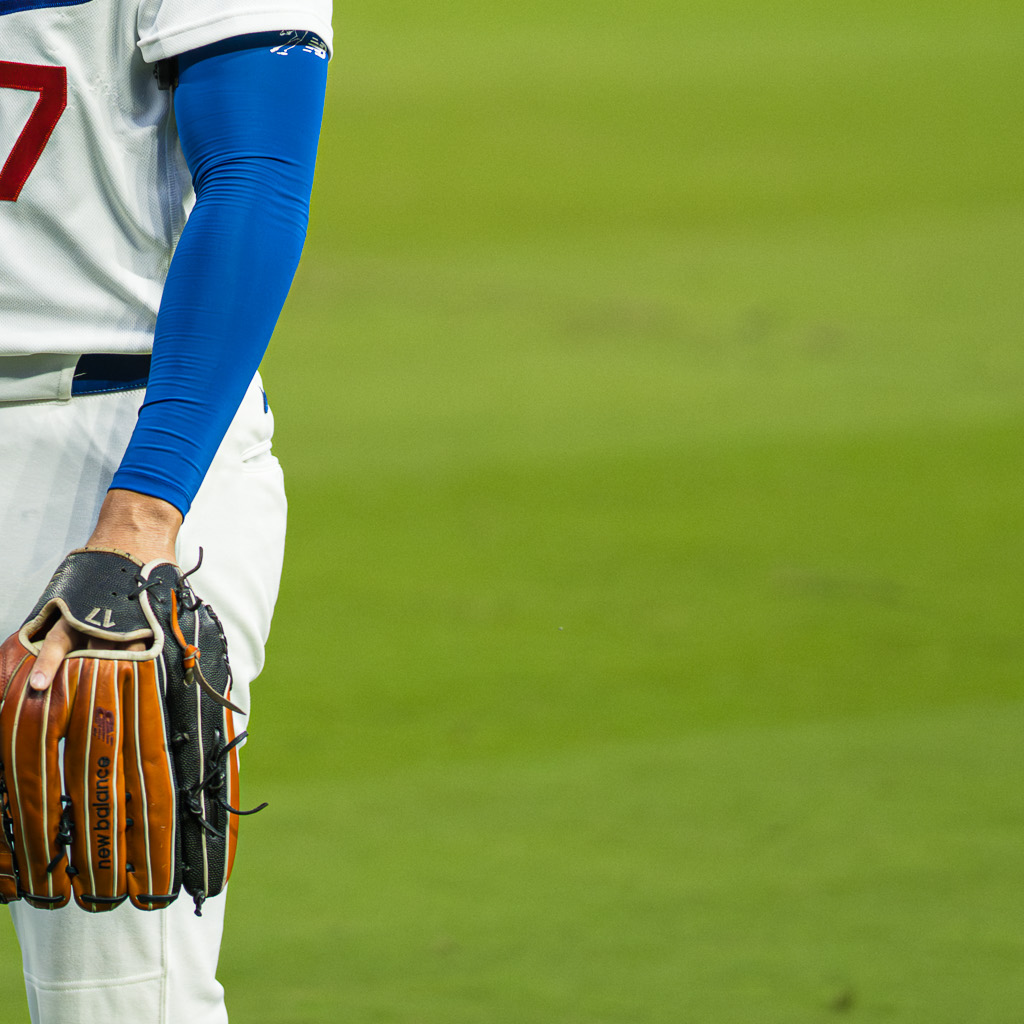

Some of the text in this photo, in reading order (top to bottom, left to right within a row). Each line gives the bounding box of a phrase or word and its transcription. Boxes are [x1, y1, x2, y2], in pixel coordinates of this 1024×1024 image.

[85, 607, 116, 628] 17
[92, 756, 111, 870] new balance
